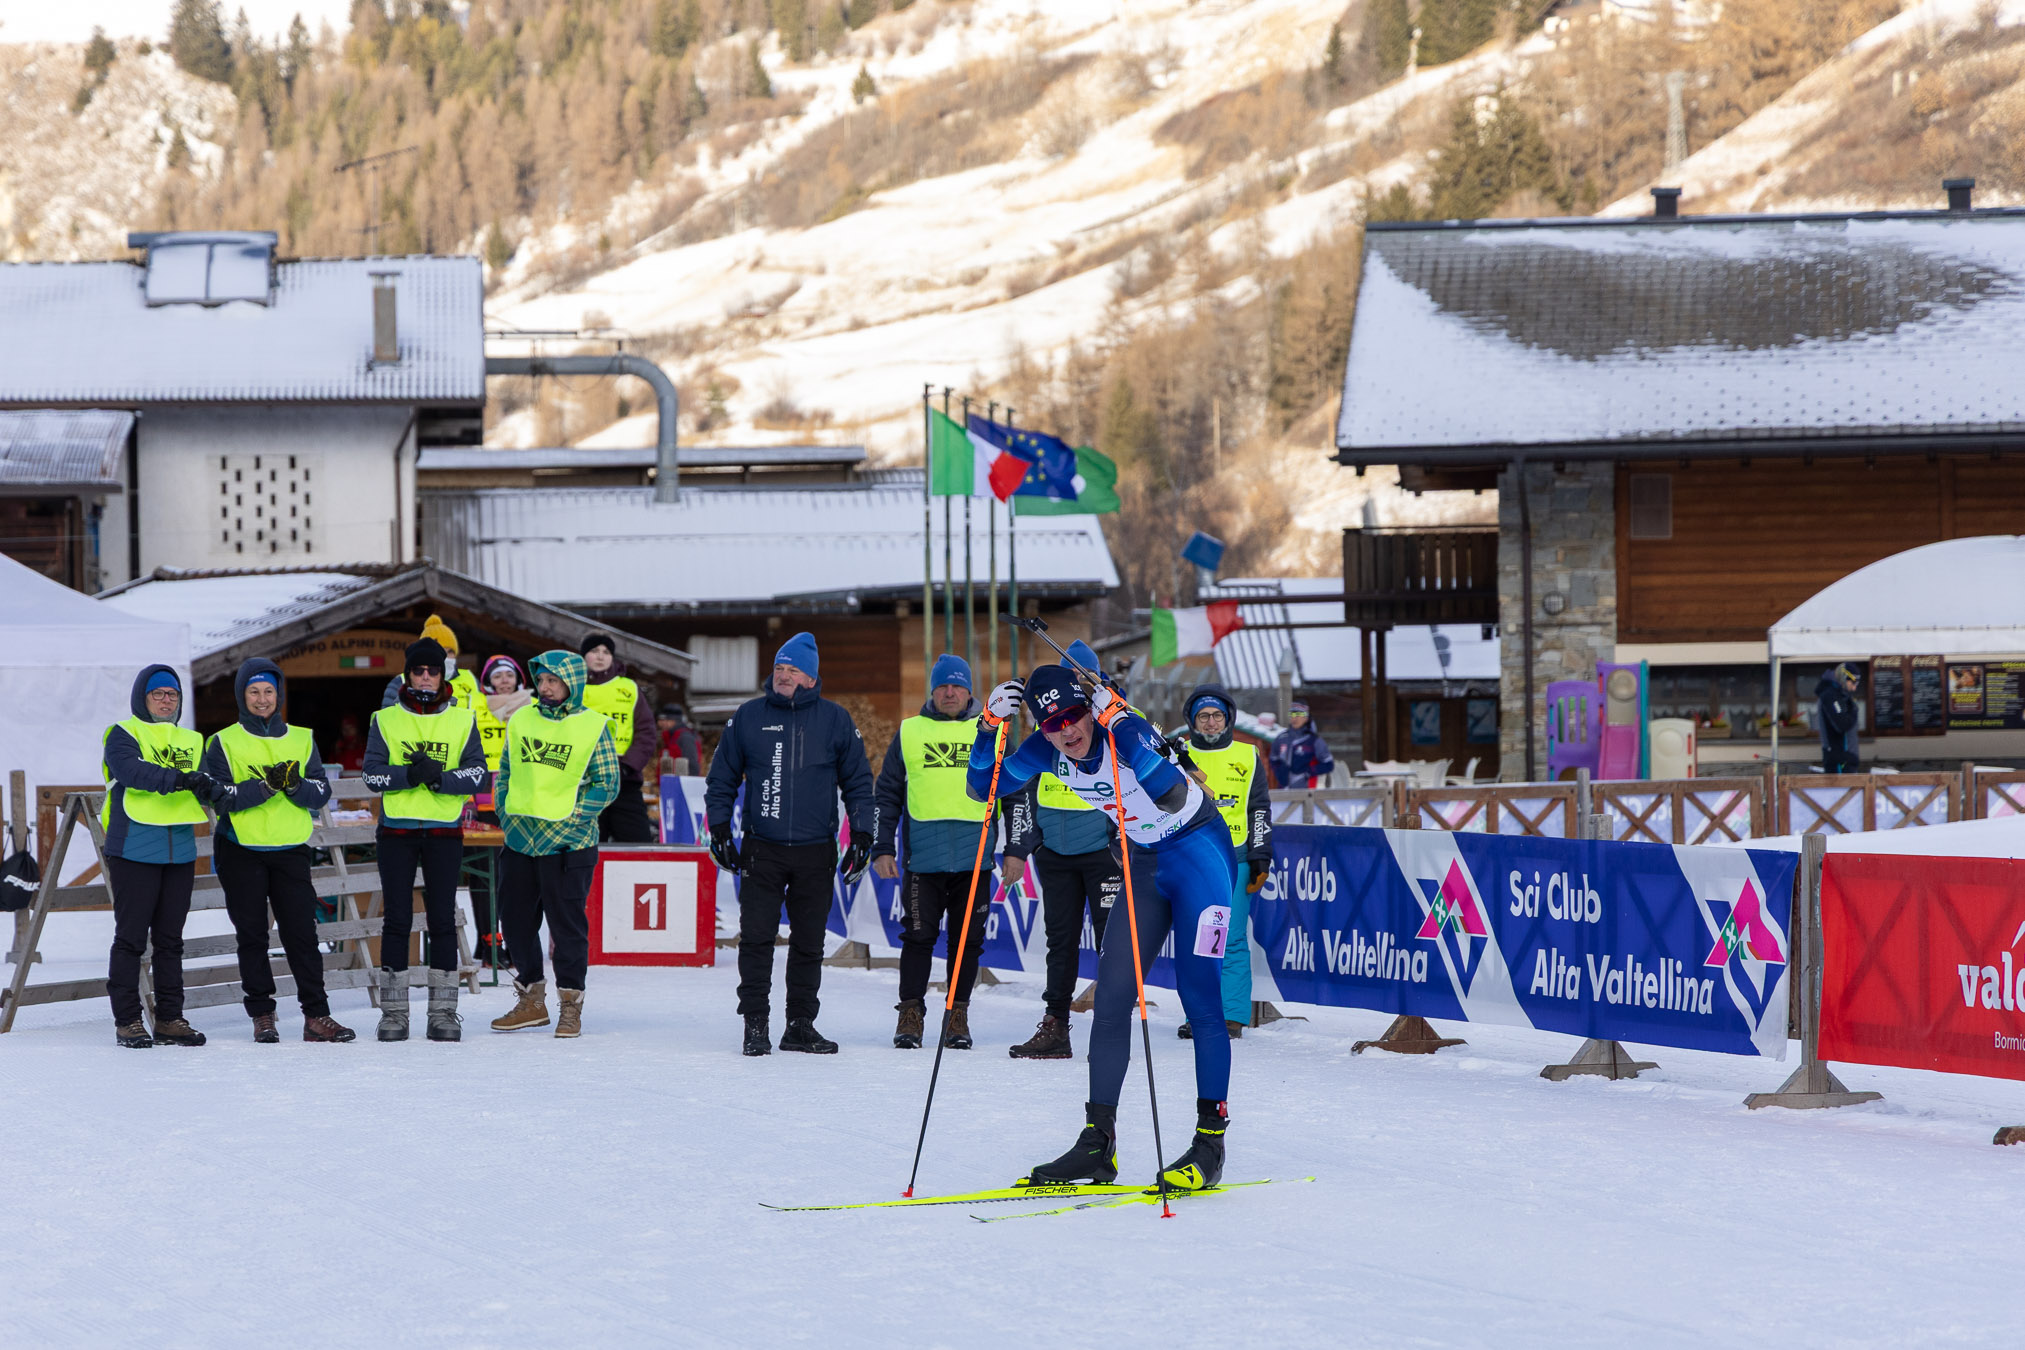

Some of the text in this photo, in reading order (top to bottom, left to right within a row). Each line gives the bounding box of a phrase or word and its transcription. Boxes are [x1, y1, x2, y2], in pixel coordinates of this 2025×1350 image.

[1034, 688, 1060, 709] ice
[761, 779, 770, 818] Sci Club
[770, 742, 783, 820] Alta Valtellina
[638, 888, 659, 929] 1
[1509, 870, 1602, 924] Sci Club
[1211, 929, 1221, 955] 2
[1530, 947, 1715, 1015] Alta Valtellina
[1025, 1186, 1079, 1195] FISCHER
